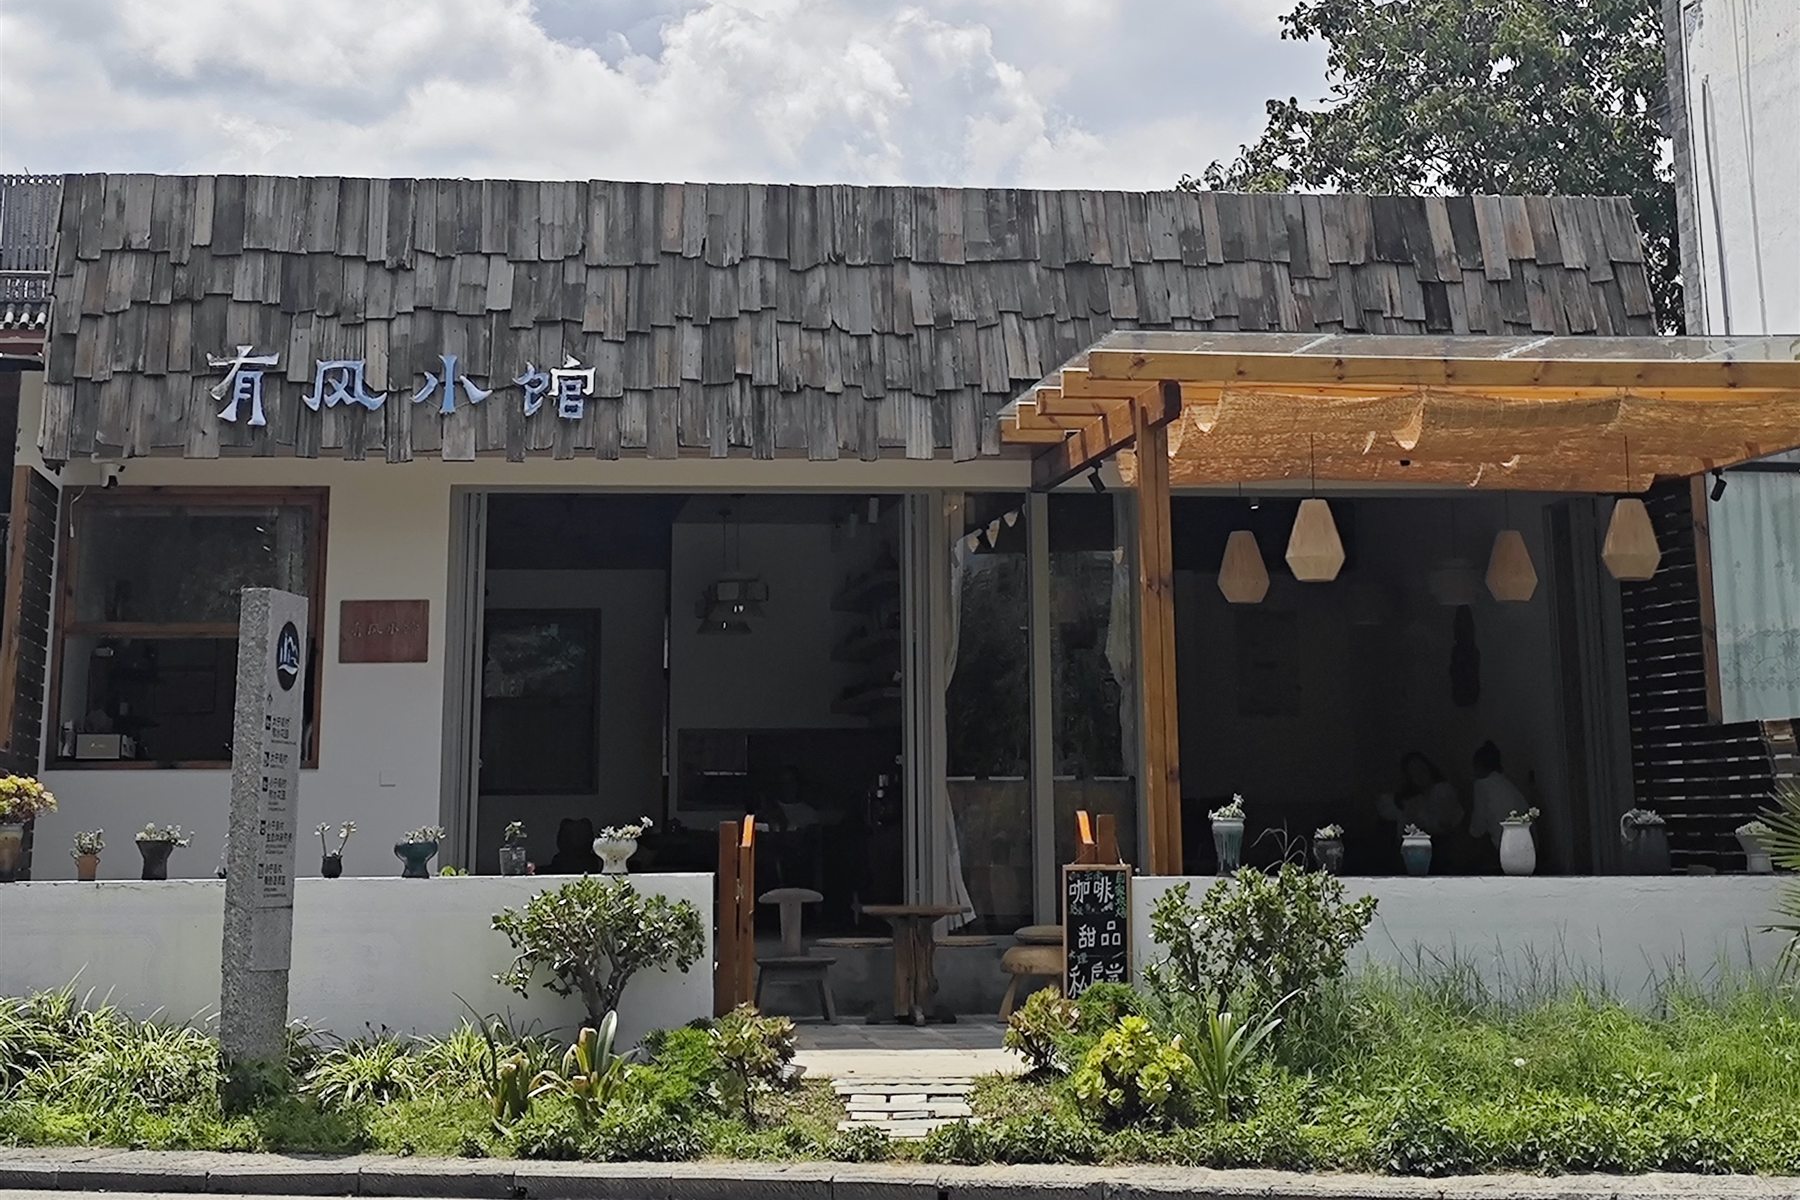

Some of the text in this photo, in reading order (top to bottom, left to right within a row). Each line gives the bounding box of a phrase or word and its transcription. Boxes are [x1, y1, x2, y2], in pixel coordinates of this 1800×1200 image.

[206, 345, 597, 426] 有风小馆
[1069, 876, 1115, 904] 咖啡
[1078, 920, 1121, 949] 甜品
